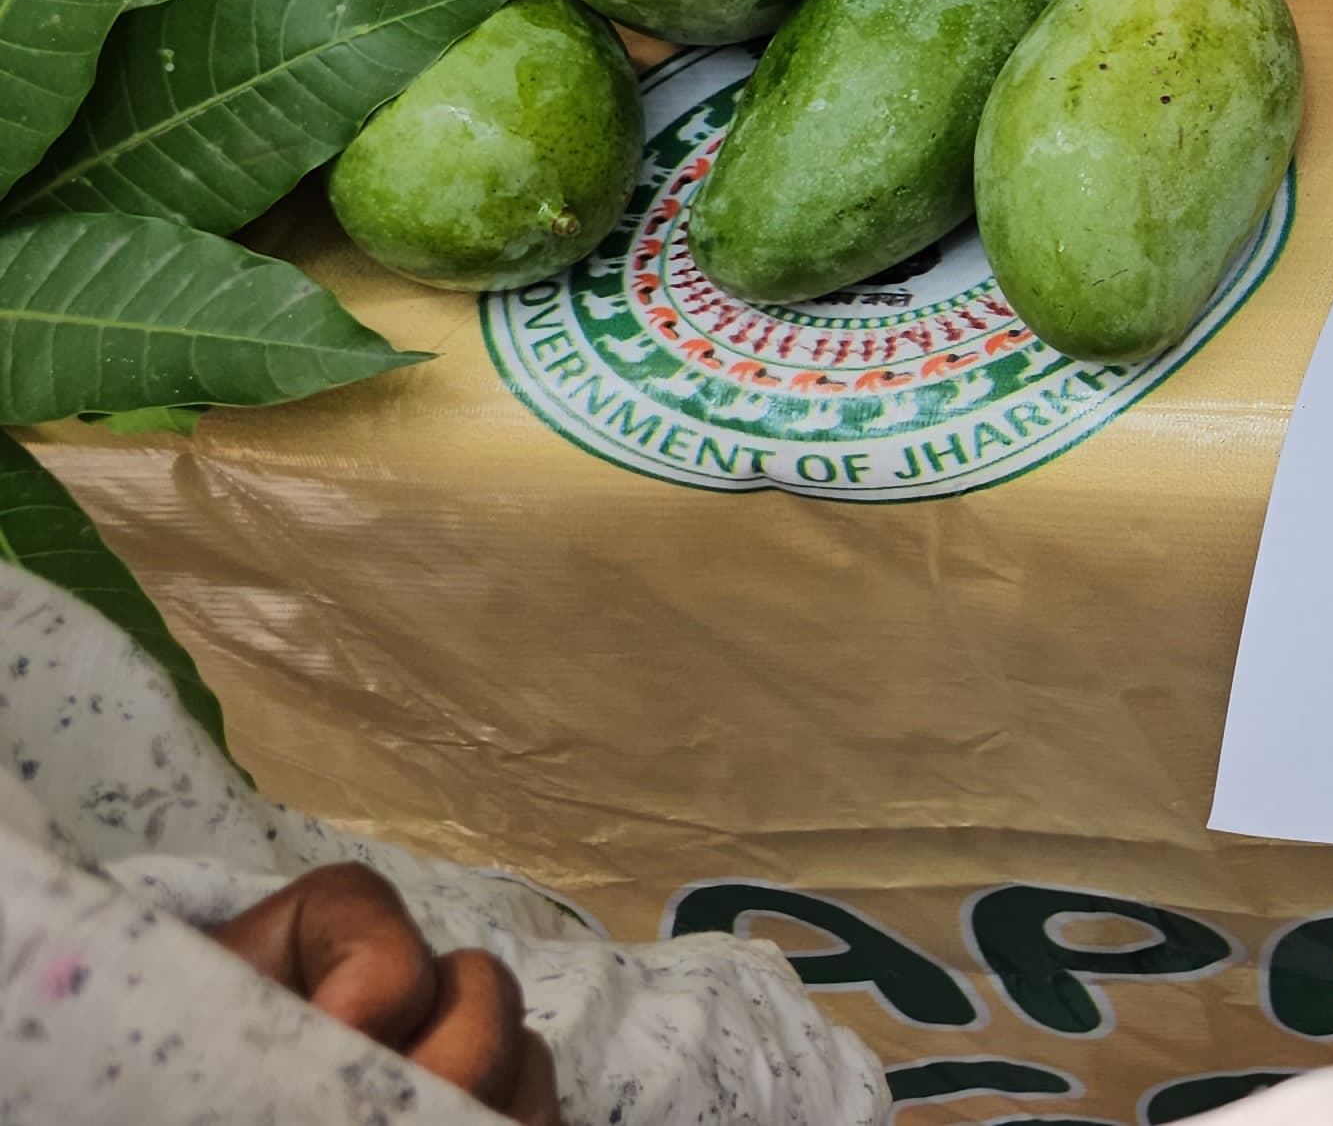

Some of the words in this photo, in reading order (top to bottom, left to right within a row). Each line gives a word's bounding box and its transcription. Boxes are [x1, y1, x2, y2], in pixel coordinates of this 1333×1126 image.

[518, 280, 777, 474] OVERNMENT
[796, 453, 873, 483] OF
[893, 362, 1139, 480] JHARKH
